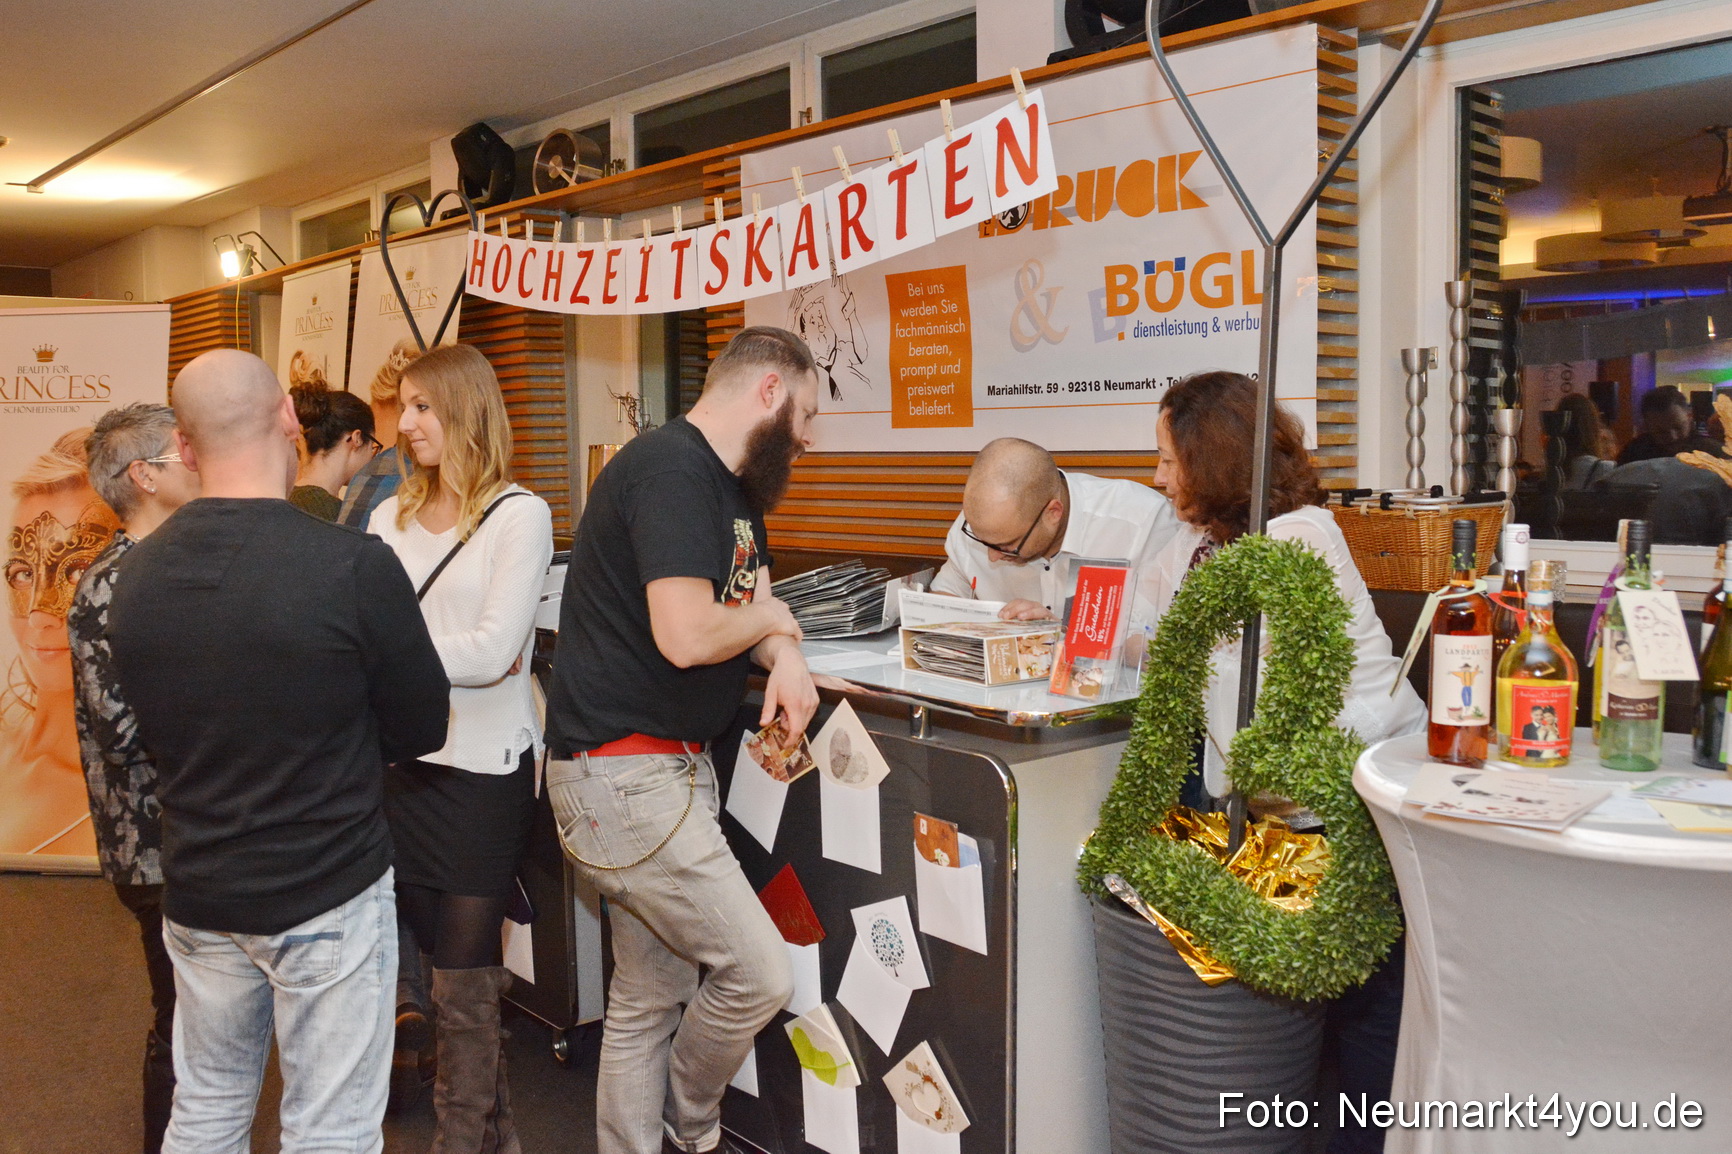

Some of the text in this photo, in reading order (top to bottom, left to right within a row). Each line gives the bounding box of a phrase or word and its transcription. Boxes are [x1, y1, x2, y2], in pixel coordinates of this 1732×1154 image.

[469, 104, 1040, 305] HOCHZEITSKARTEN
[908, 282, 945, 297] Bei uns
[1104, 249, 1262, 317] BÖGL
[900, 299, 958, 318] werden Sie
[895, 317, 966, 338] fachmännisch
[1133, 313, 1261, 338] dienstleistung & werbu
[908, 342, 953, 357] beraten,
[17, 365, 70, 374] BEAUTY FOR
[900, 359, 961, 381] prompt und
[0, 374, 111, 400] RINCESS
[908, 382, 955, 400] preiswert
[987, 384, 1044, 396] Mariahilfstr.
[1046, 382, 1059, 394] 59
[1068, 381, 1101, 393] 92318
[1104, 378, 1156, 391] Neumarkt
[909, 400, 955, 416] beliefert.
[1085, 586, 1104, 642] Gutschein
[1097, 629, 1105, 642] 10%
